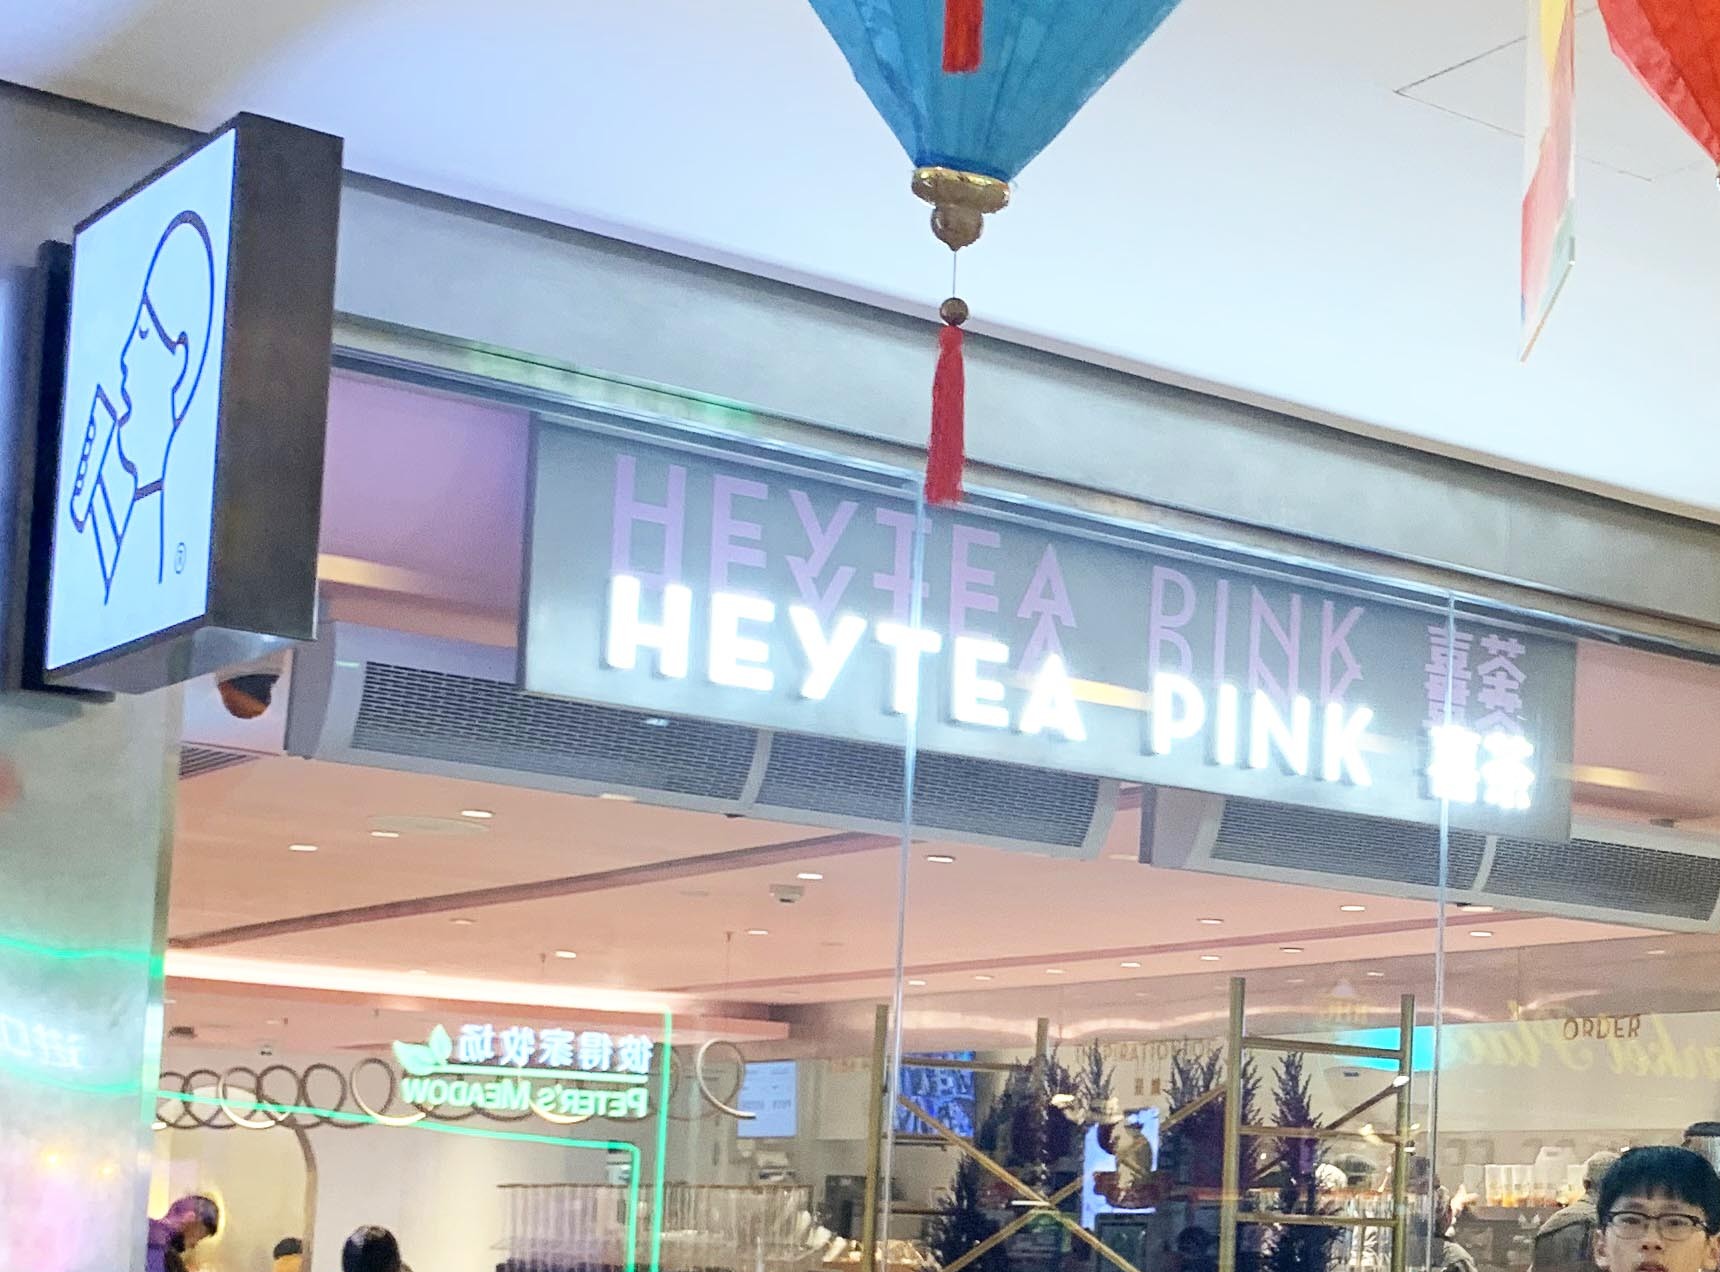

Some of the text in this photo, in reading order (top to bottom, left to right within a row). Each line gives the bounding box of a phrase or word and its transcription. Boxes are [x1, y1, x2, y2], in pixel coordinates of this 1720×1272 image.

[606, 574, 1375, 787] HEYTEA PINK
[1562, 1013, 1641, 1041] ORDER
